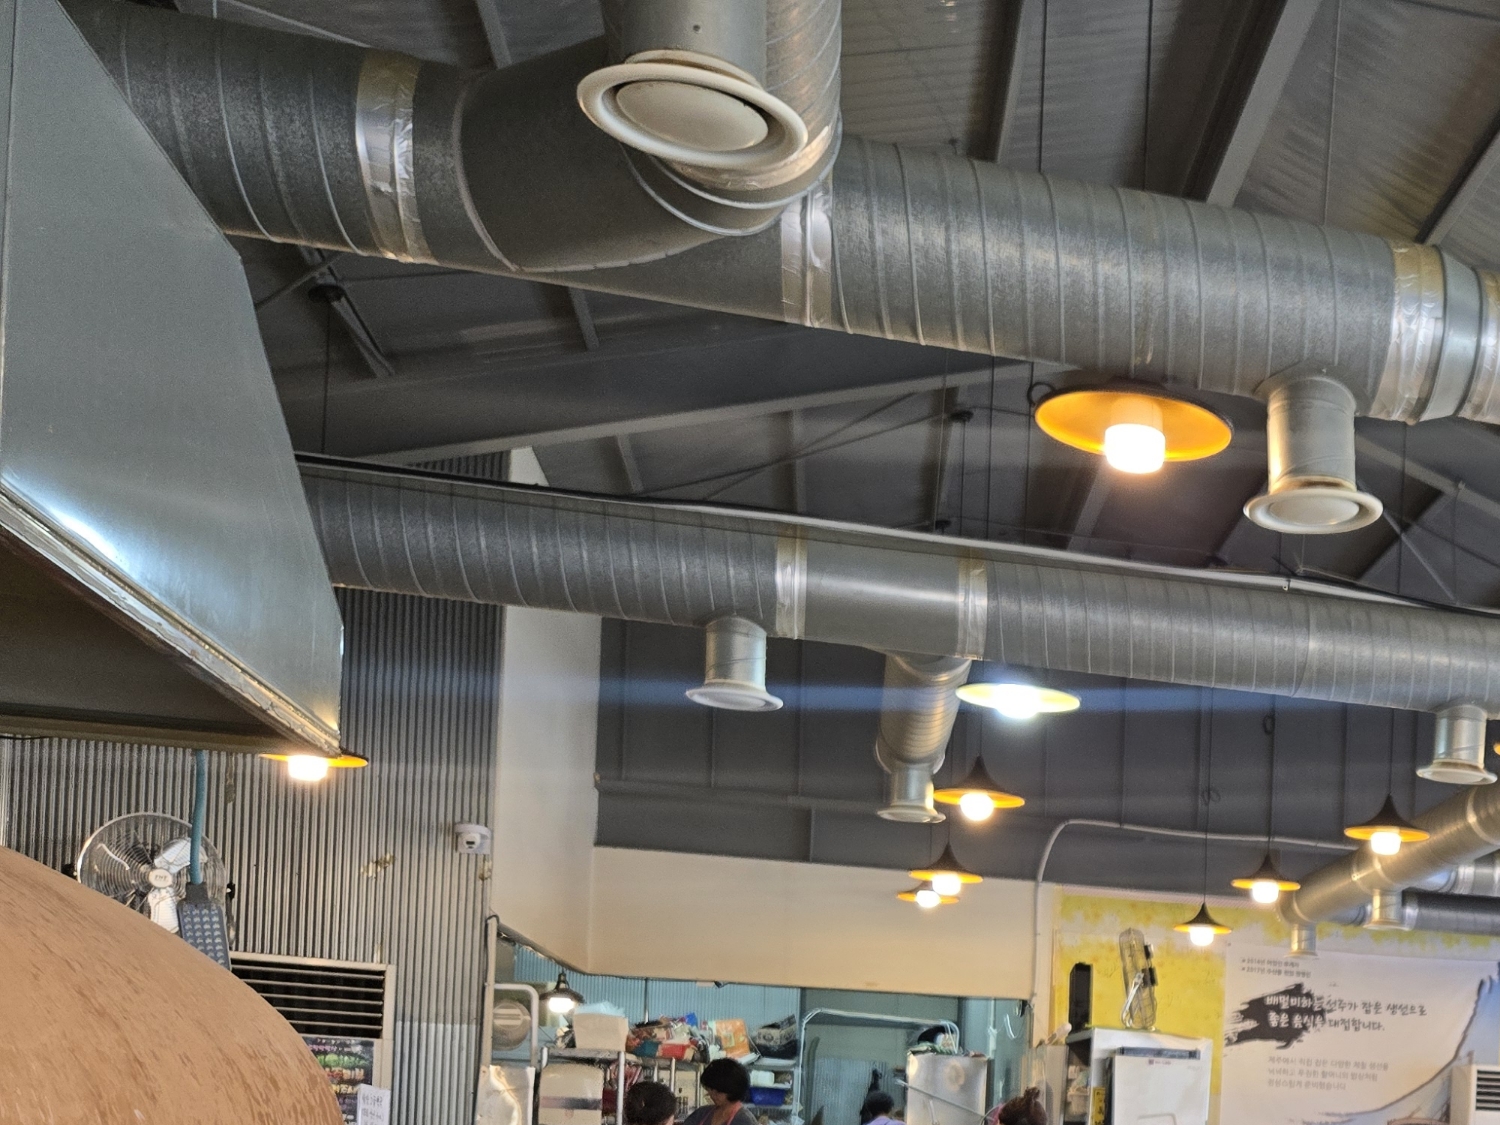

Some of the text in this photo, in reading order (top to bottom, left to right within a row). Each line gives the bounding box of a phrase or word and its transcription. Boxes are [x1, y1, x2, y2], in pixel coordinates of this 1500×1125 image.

[1265, 994, 1427, 1016] 배멀미하는 선주가 잡은 생선으로
[1268, 1011, 1289, 1028] 좋은
[1328, 1017, 1386, 1032] 대접합니다.
